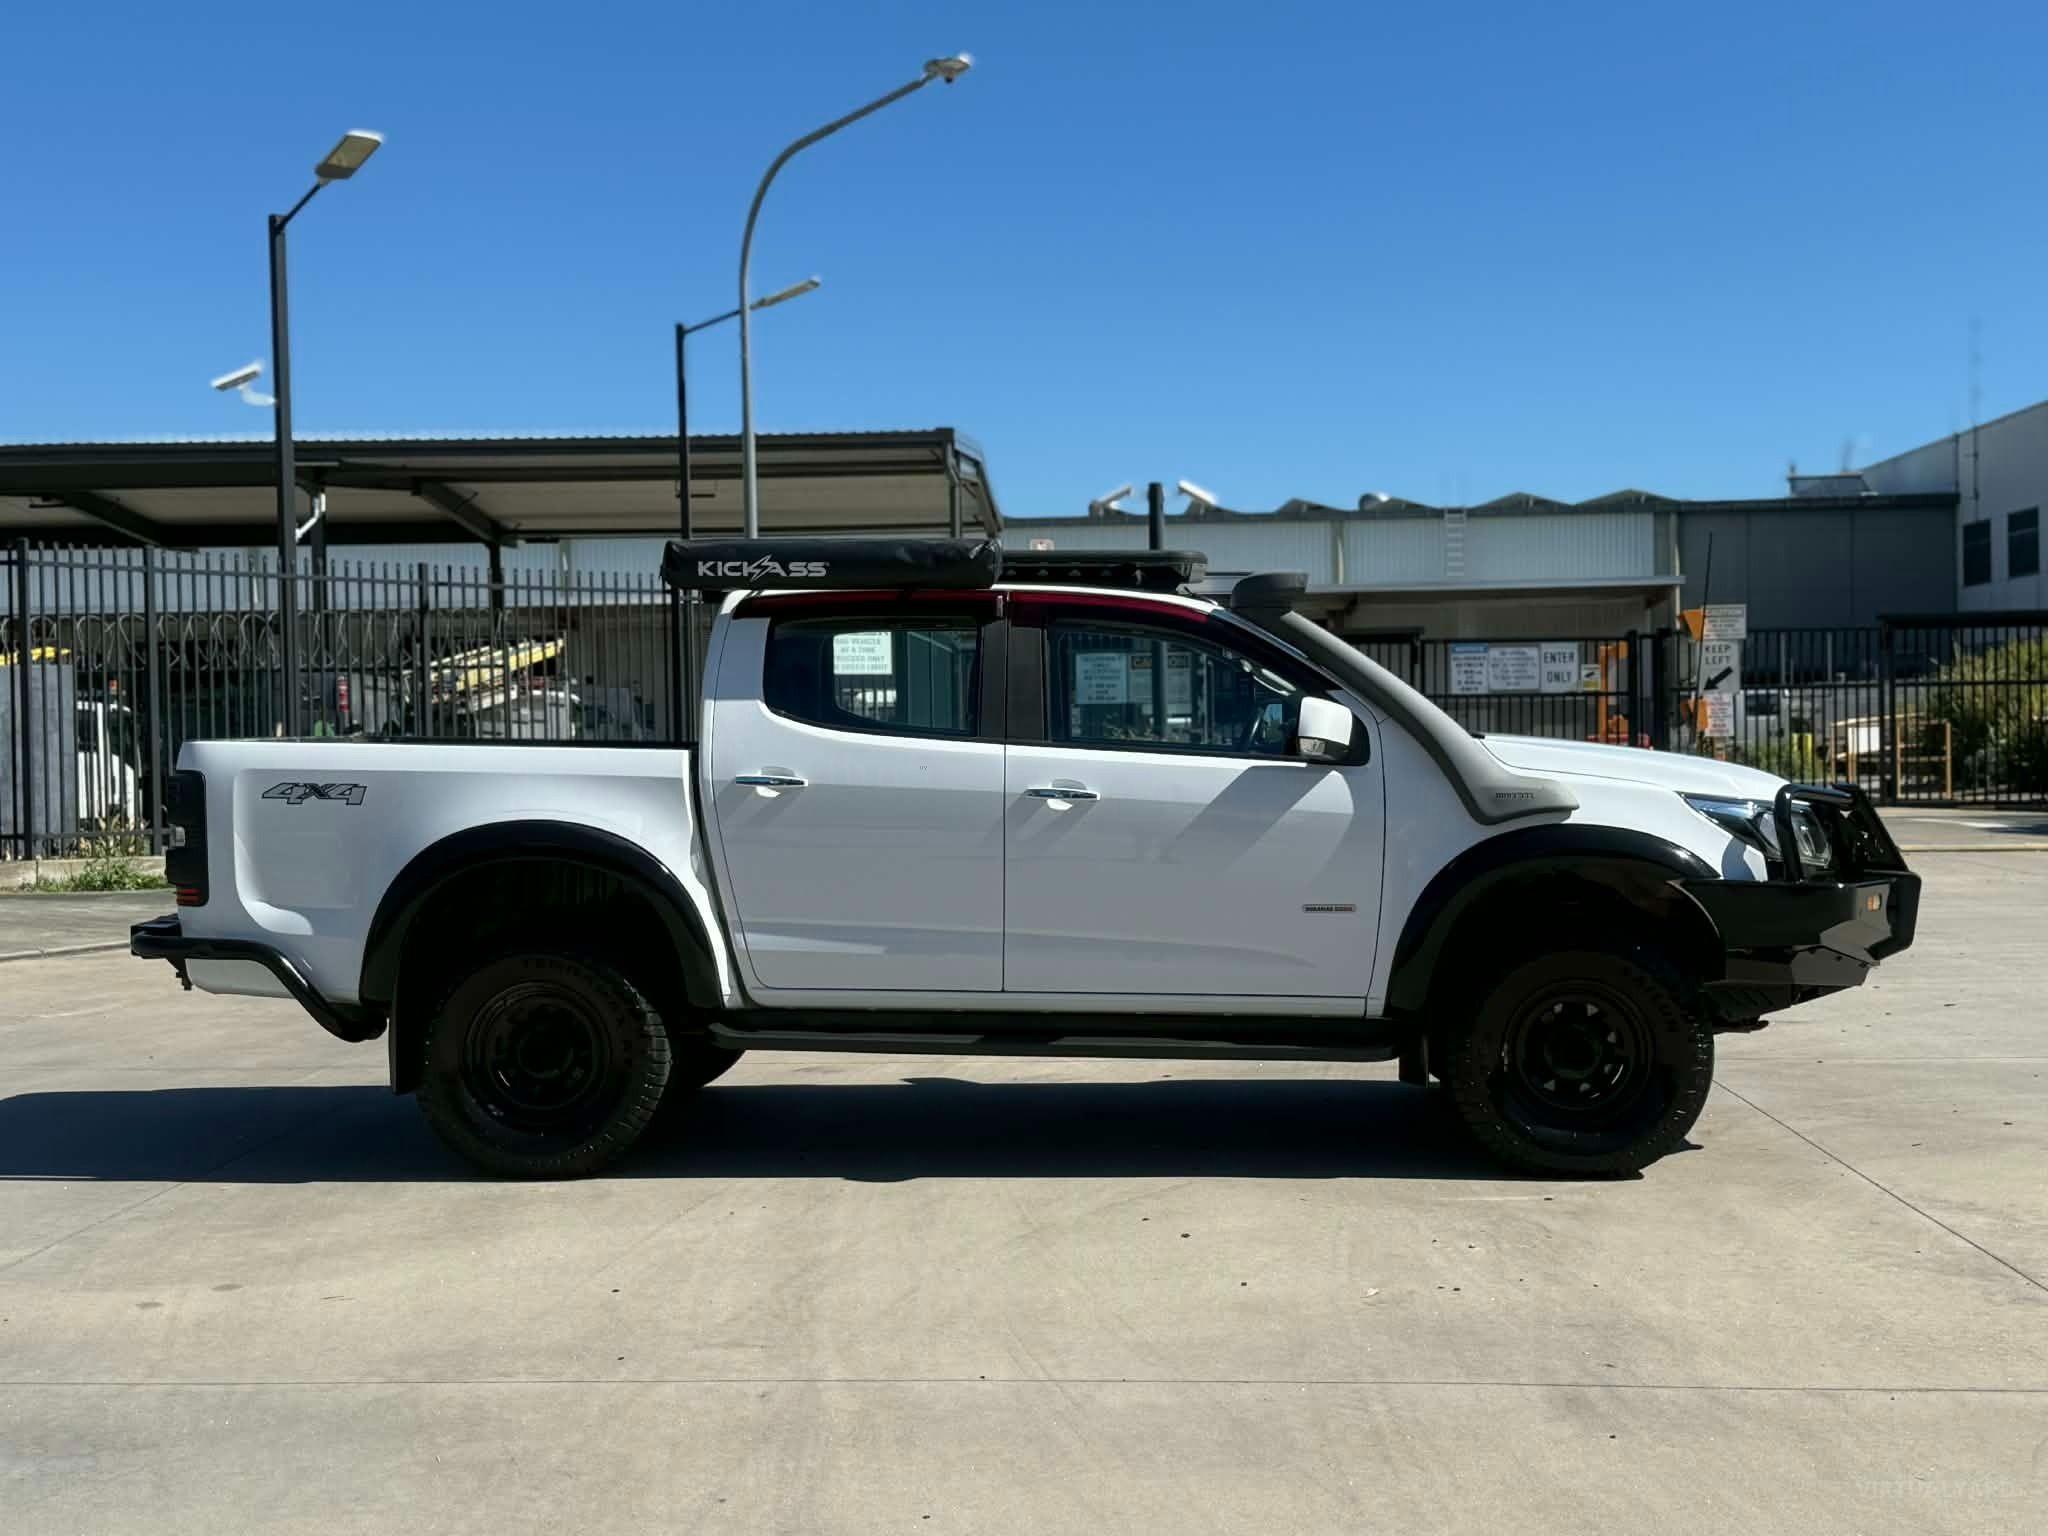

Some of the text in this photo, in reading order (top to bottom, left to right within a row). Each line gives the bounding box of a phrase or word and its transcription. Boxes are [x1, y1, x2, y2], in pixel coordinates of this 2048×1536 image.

[698, 559, 827, 578] KICKASS
[1704, 644, 1731, 654] KEEP
[1543, 651, 1575, 664] ENTER
[1704, 655, 1731, 665] LEFT
[1546, 671, 1572, 683] ONLY
